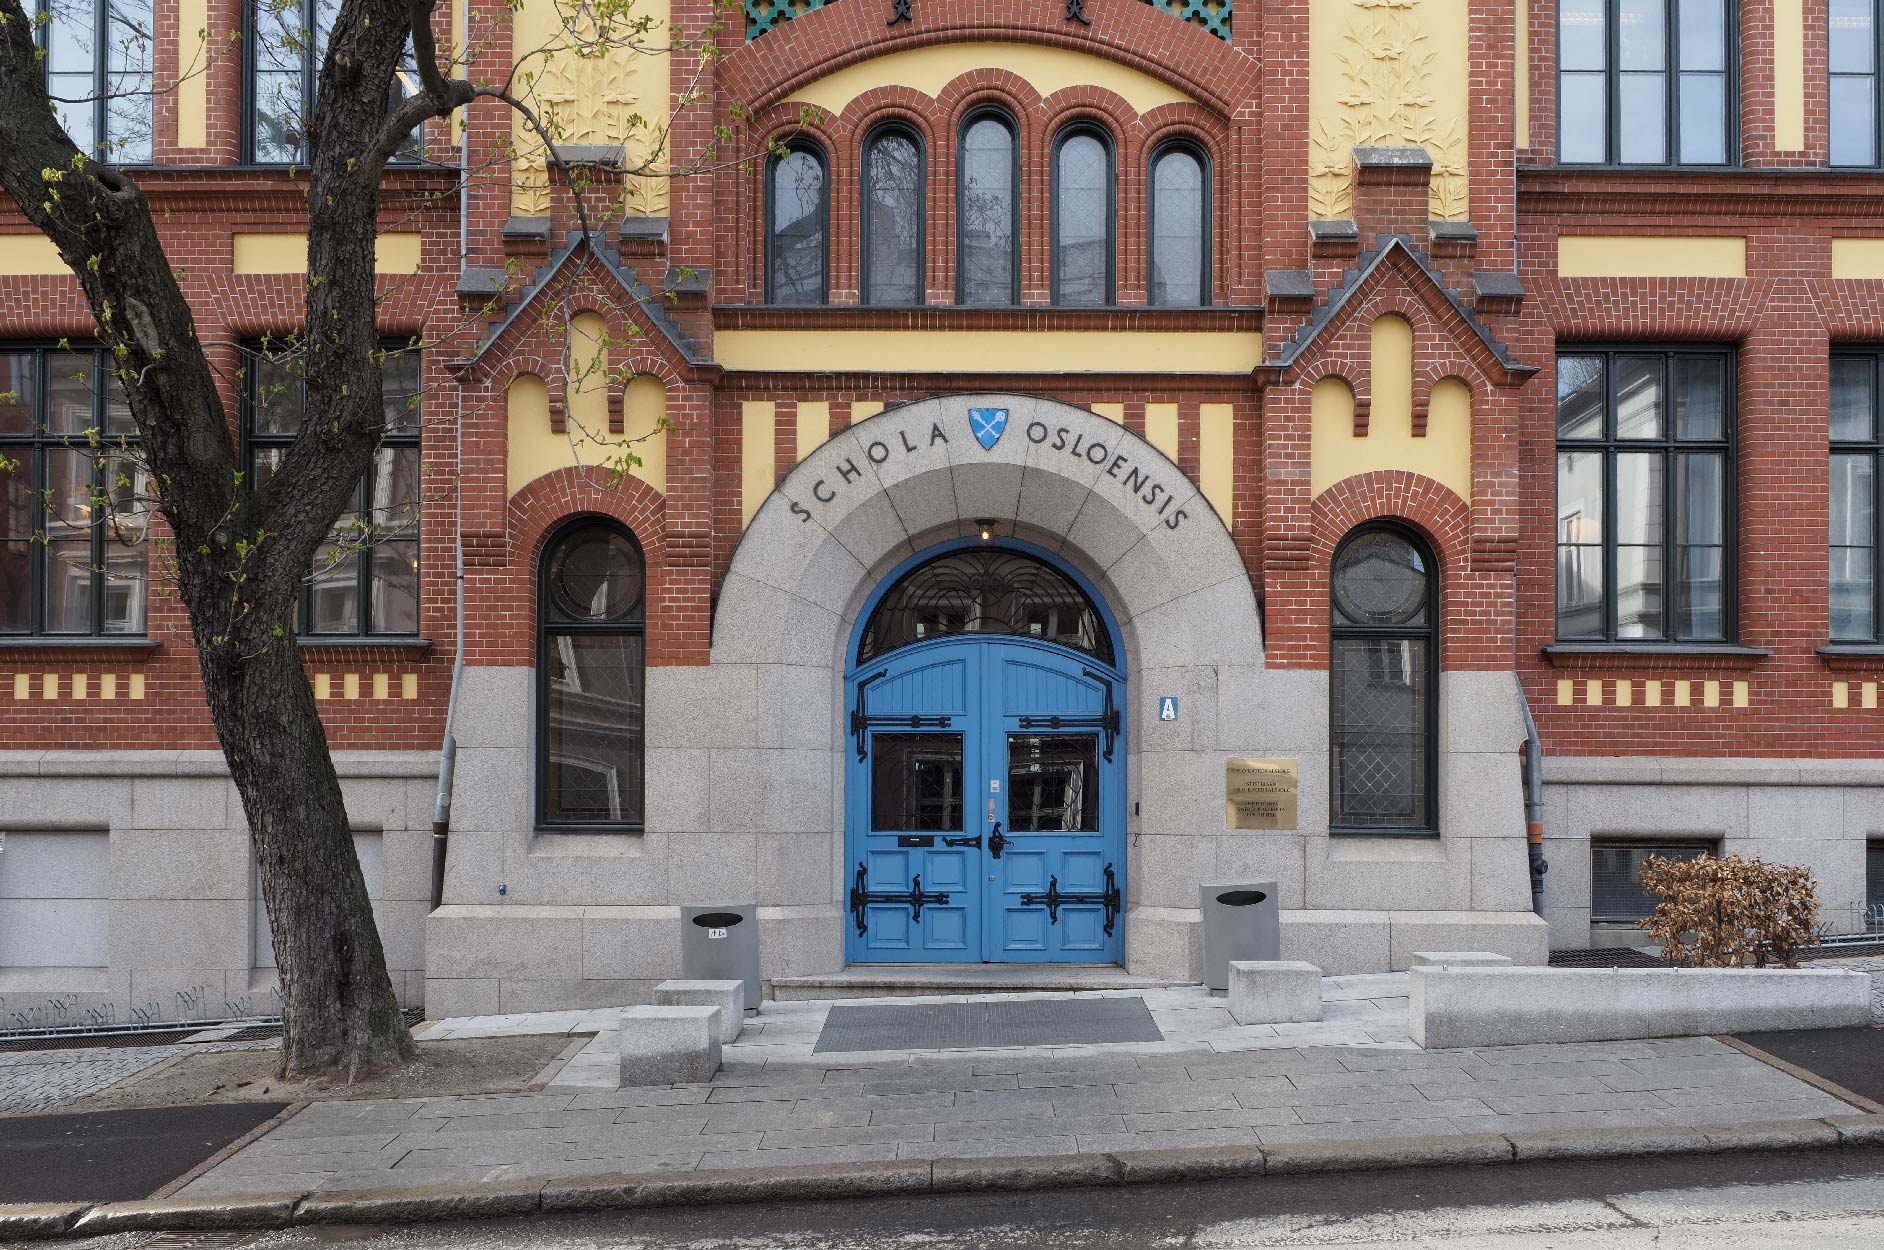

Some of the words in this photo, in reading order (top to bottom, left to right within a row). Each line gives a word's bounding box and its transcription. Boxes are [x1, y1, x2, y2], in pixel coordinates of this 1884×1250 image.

[790, 422, 948, 523] SCHOLA
[1027, 422, 1188, 530] OSLOENSIS
[1161, 698, 1176, 719] A
